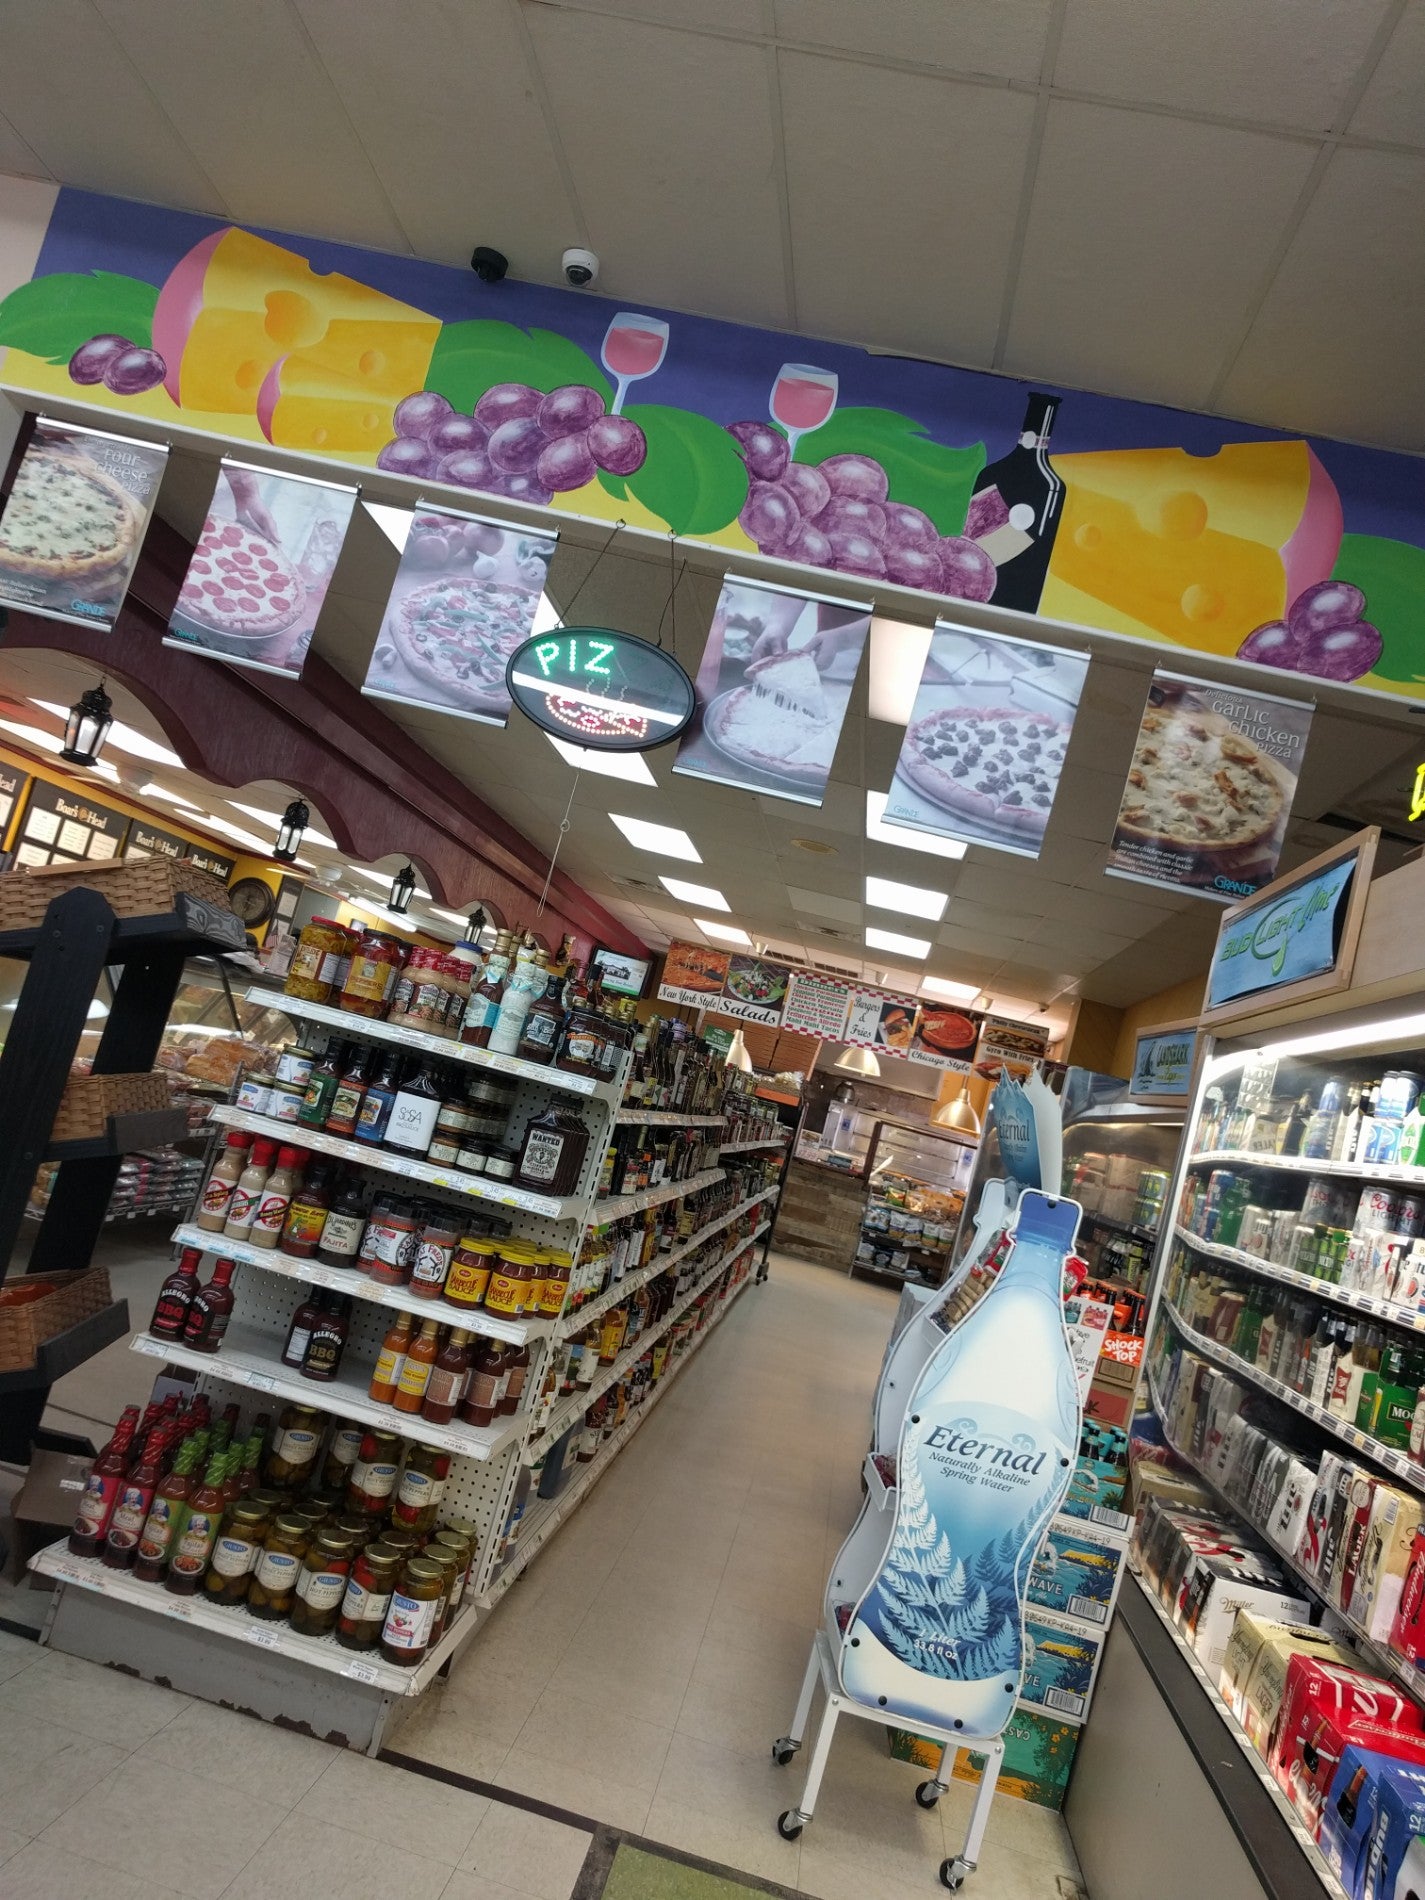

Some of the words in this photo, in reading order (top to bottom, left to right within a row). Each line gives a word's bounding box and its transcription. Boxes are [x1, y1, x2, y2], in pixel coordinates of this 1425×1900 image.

[86, 812, 108, 830] Head
[1214, 875, 1257, 895] GRANDE
[1220, 932, 1254, 962] BUD
[1256, 906, 1303, 947] LIGHT
[660, 986, 677, 999] New
[677, 990, 698, 1006] York
[699, 995, 718, 1010] Style
[854, 995, 881, 1013] Burgers
[720, 999, 777, 1025] Salads
[850, 1024, 872, 1038] Fries
[986, 1045, 1002, 1055] Gyro
[911, 1050, 945, 1066] Chicago
[946, 1060, 970, 1072] Style
[532, 1133, 560, 1147] WANTED
[323, 1237, 348, 1249] FAJITA
[161, 1288, 191, 1304] ALLEGRO
[157, 1301, 184, 1319] BBQ
[312, 1330, 342, 1346] ALLEGRO
[1104, 1338, 1143, 1352] SHOCK
[310, 1344, 336, 1362] BBQ
[1112, 1350, 1138, 1363] TOP
[924, 1425, 1047, 1476] Eternal
[928, 1451, 983, 1474] Naturally
[984, 1467, 1031, 1486] Alkaline
[940, 1466, 977, 1485] Spring
[980, 1477, 1014, 1493] Water
[1348, 1525, 1367, 1577] LAGER
[1030, 1576, 1064, 1595] WAVE
[1220, 1597, 1254, 1615] Miller
[929, 1631, 962, 1648] Liter
[914, 1639, 935, 1653] 33.8
[936, 1645, 943, 1656] fl
[944, 1651, 958, 1660] oz
[1024, 1672, 1041, 1687] VE
[1308, 1682, 1320, 1696] 12
[1408, 1814, 1422, 1832] 12
